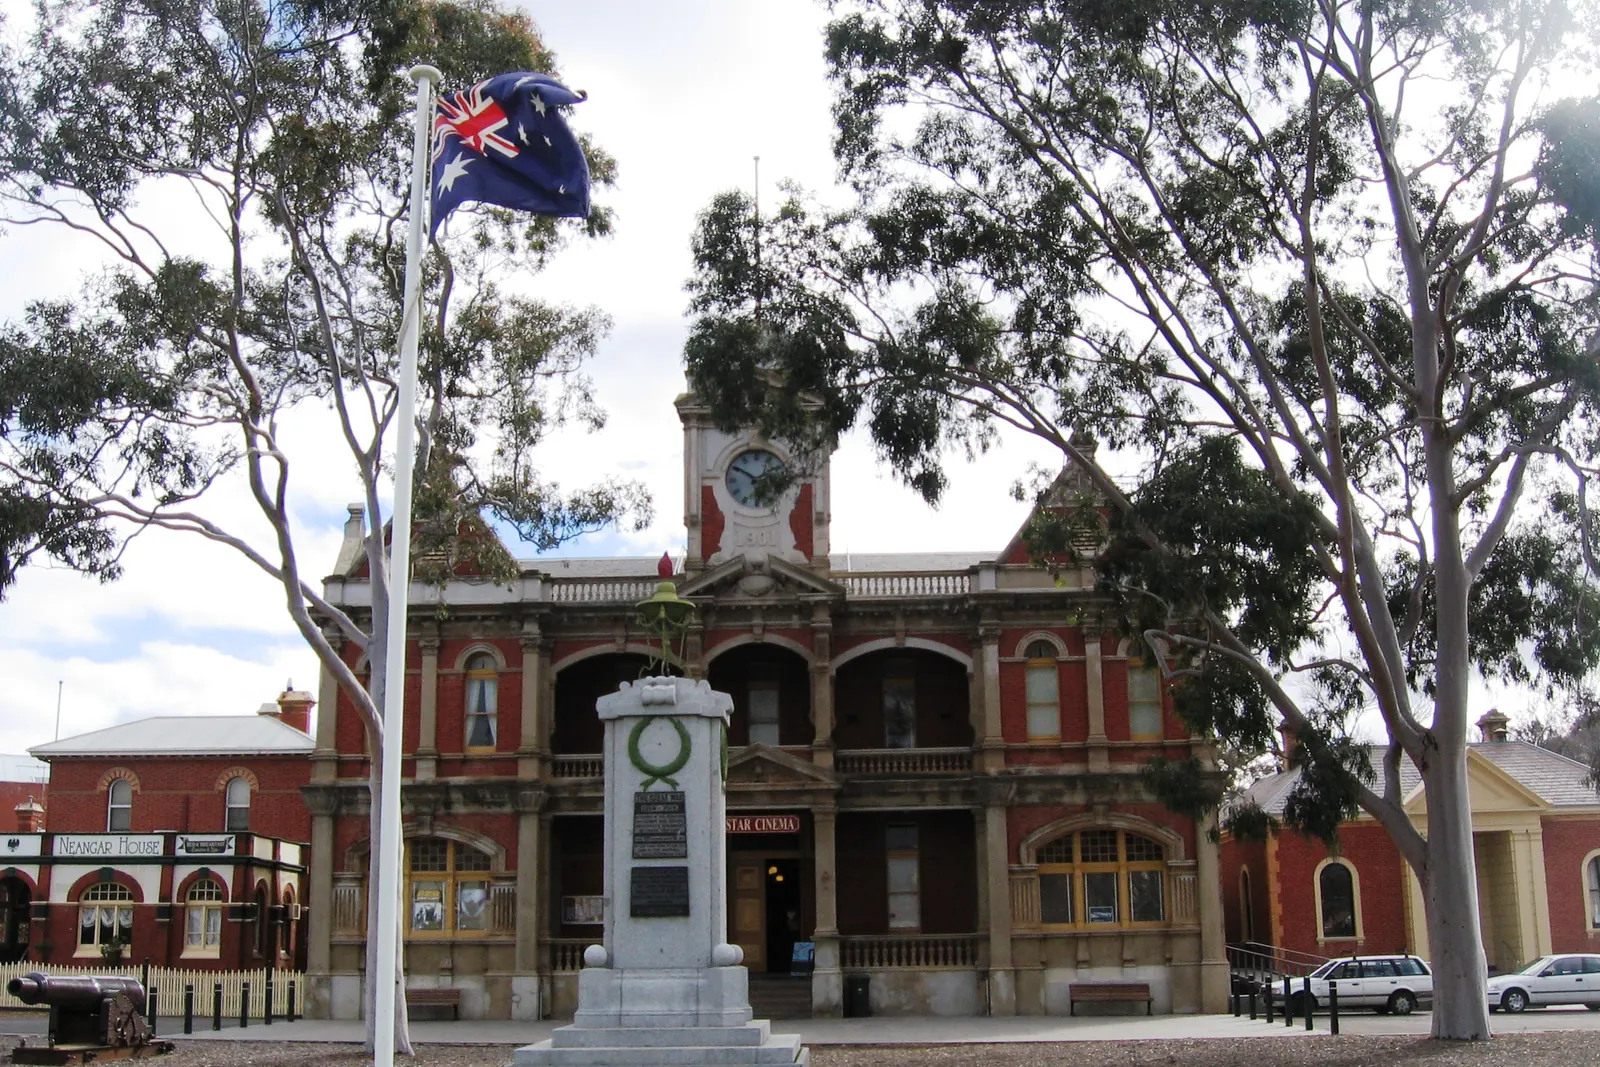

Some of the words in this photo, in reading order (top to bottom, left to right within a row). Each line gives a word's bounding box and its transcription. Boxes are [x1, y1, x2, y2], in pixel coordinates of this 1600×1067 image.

[726, 818, 751, 831] STAR
[755, 817, 794, 831] CINEMA
[59, 837, 112, 855] NEANGAR
[119, 837, 160, 855] HOUSE
